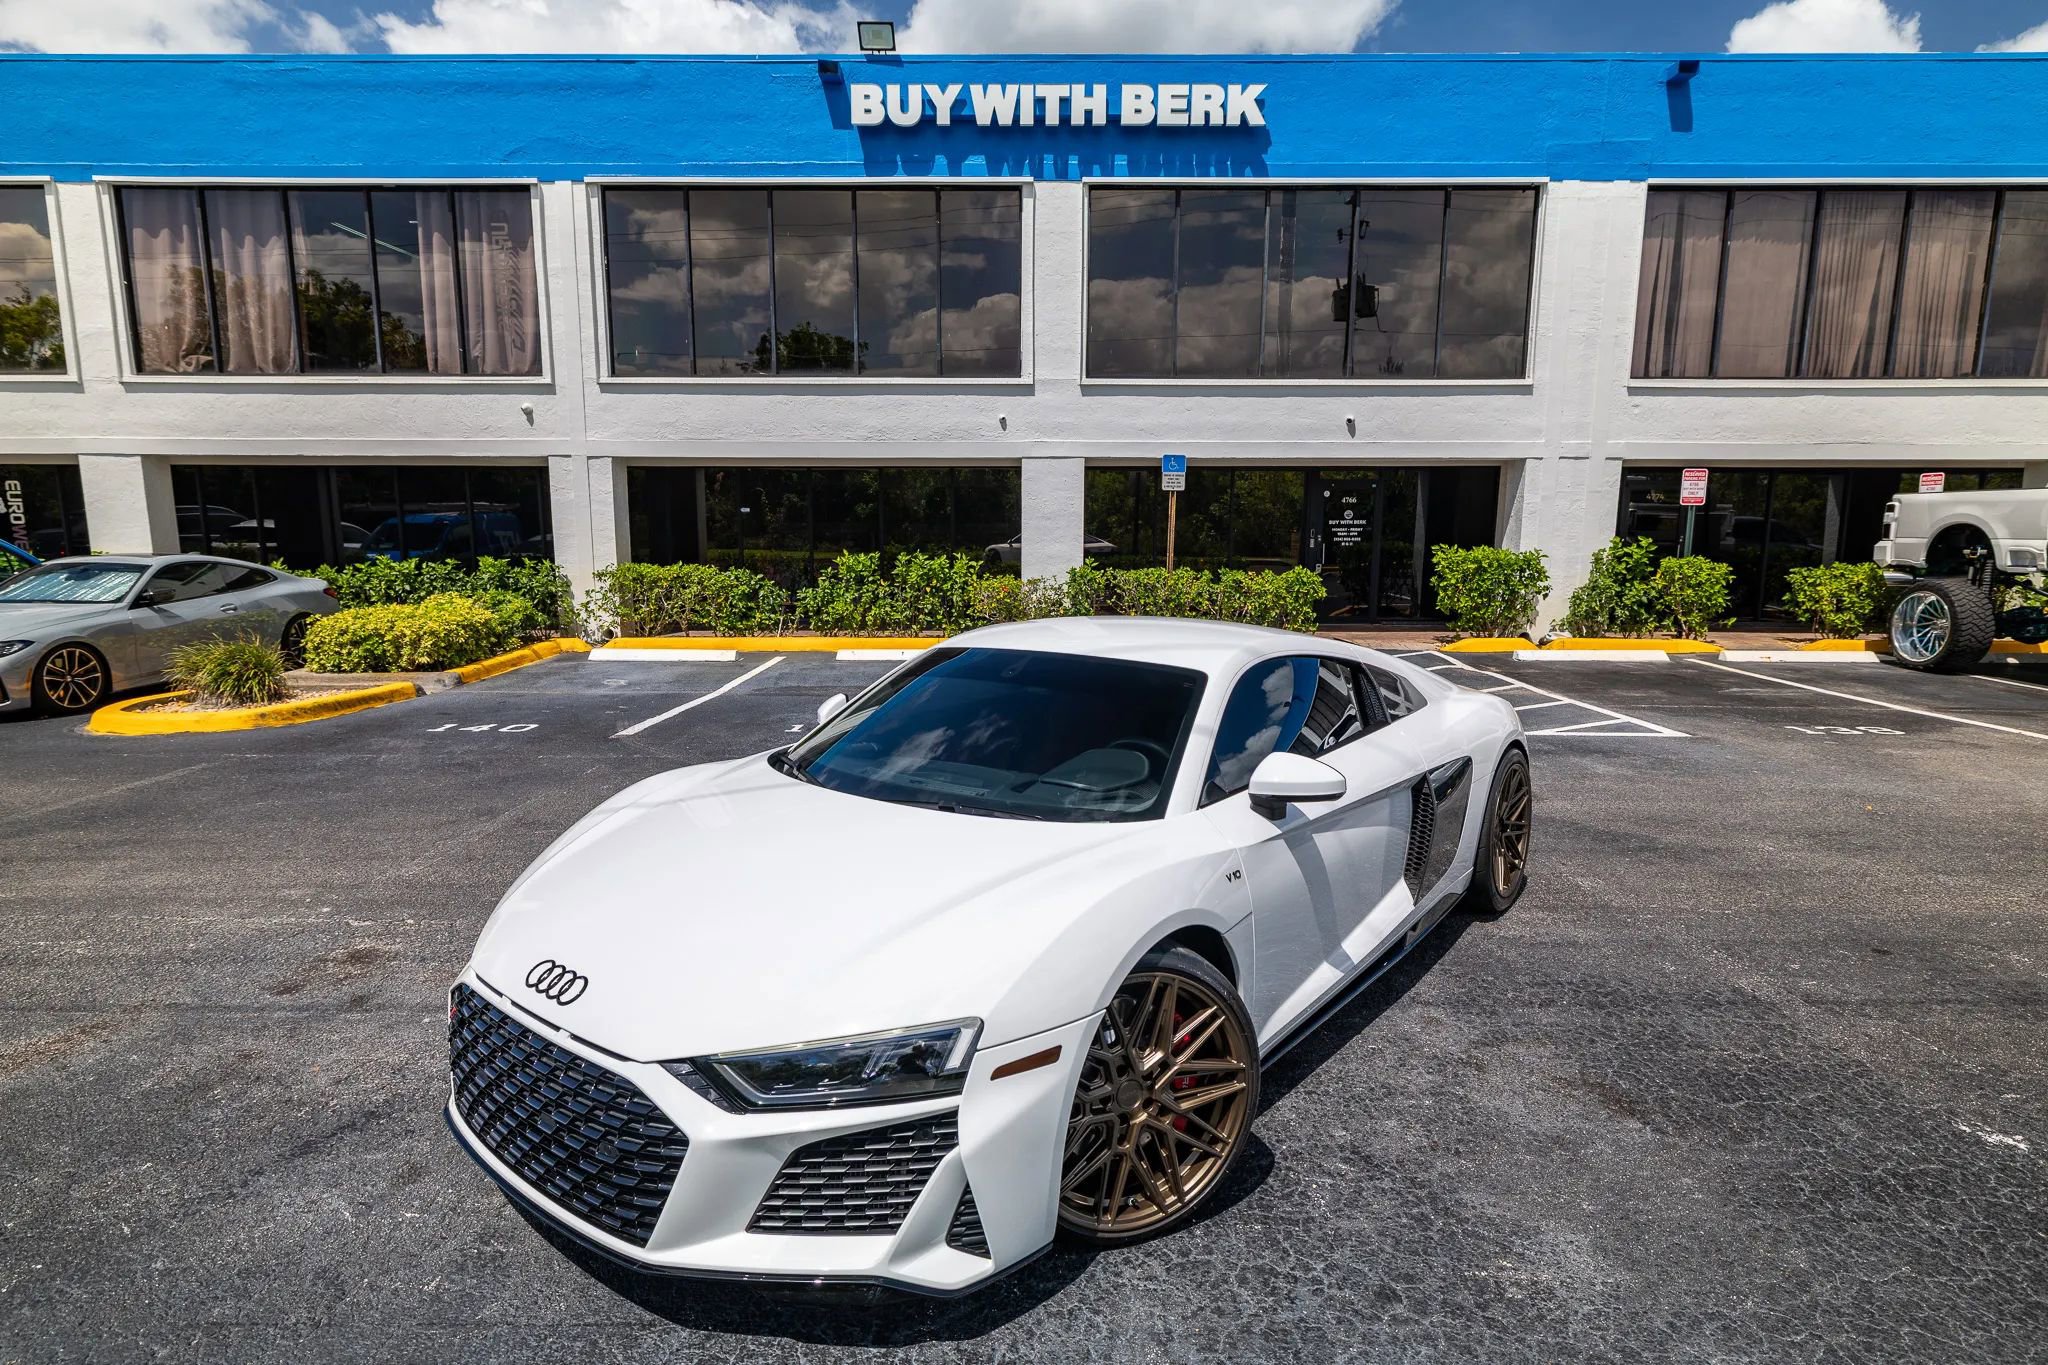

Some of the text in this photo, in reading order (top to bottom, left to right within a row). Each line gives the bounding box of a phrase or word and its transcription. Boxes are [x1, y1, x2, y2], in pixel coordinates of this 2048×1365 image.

[850, 83, 1268, 127] BUY WITH BERK
[426, 723, 539, 732] 140
